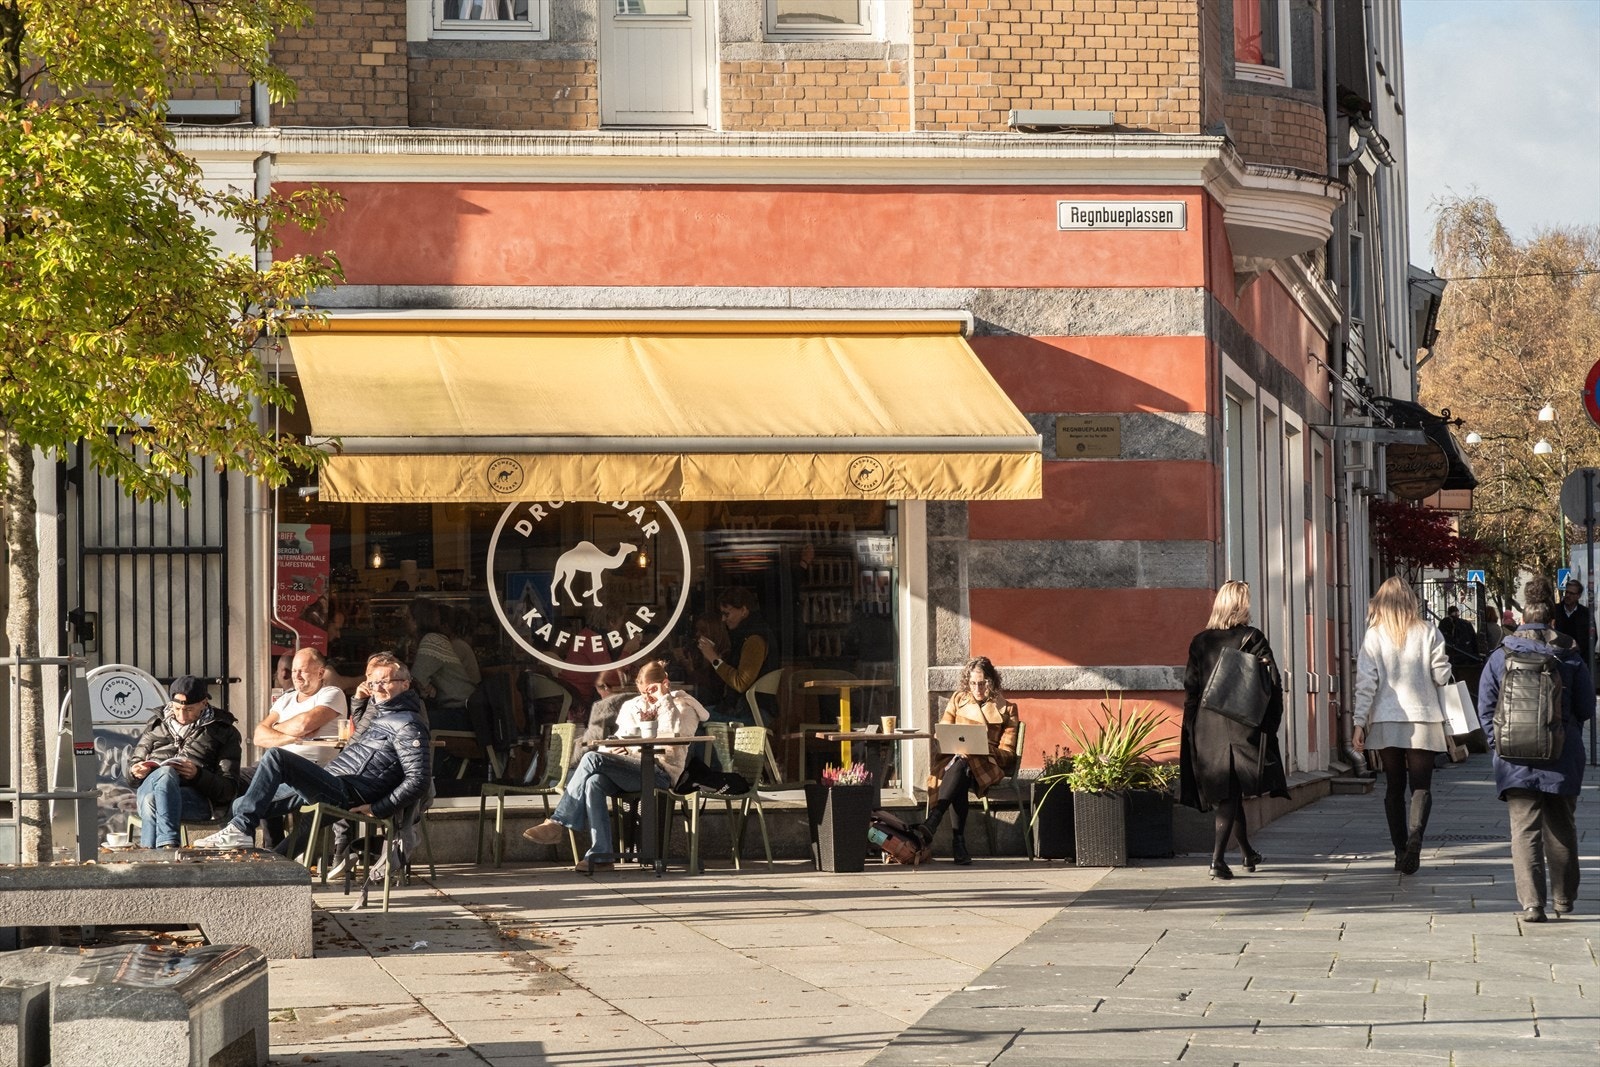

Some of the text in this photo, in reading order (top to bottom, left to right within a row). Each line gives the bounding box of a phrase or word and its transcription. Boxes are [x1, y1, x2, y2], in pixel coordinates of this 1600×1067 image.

[1070, 206, 1174, 227] Regnbueplassen
[491, 460, 519, 471] DROMEDAR
[493, 481, 518, 491] KAFFEBAR
[280, 532, 294, 540] BIFF
[277, 593, 311, 602] oktober
[276, 604, 297, 612] 2025
[522, 605, 656, 653] KAFFEBAR
[105, 679, 136, 692] DROMEDAR
[109, 704, 137, 716] KAFFEBAR
